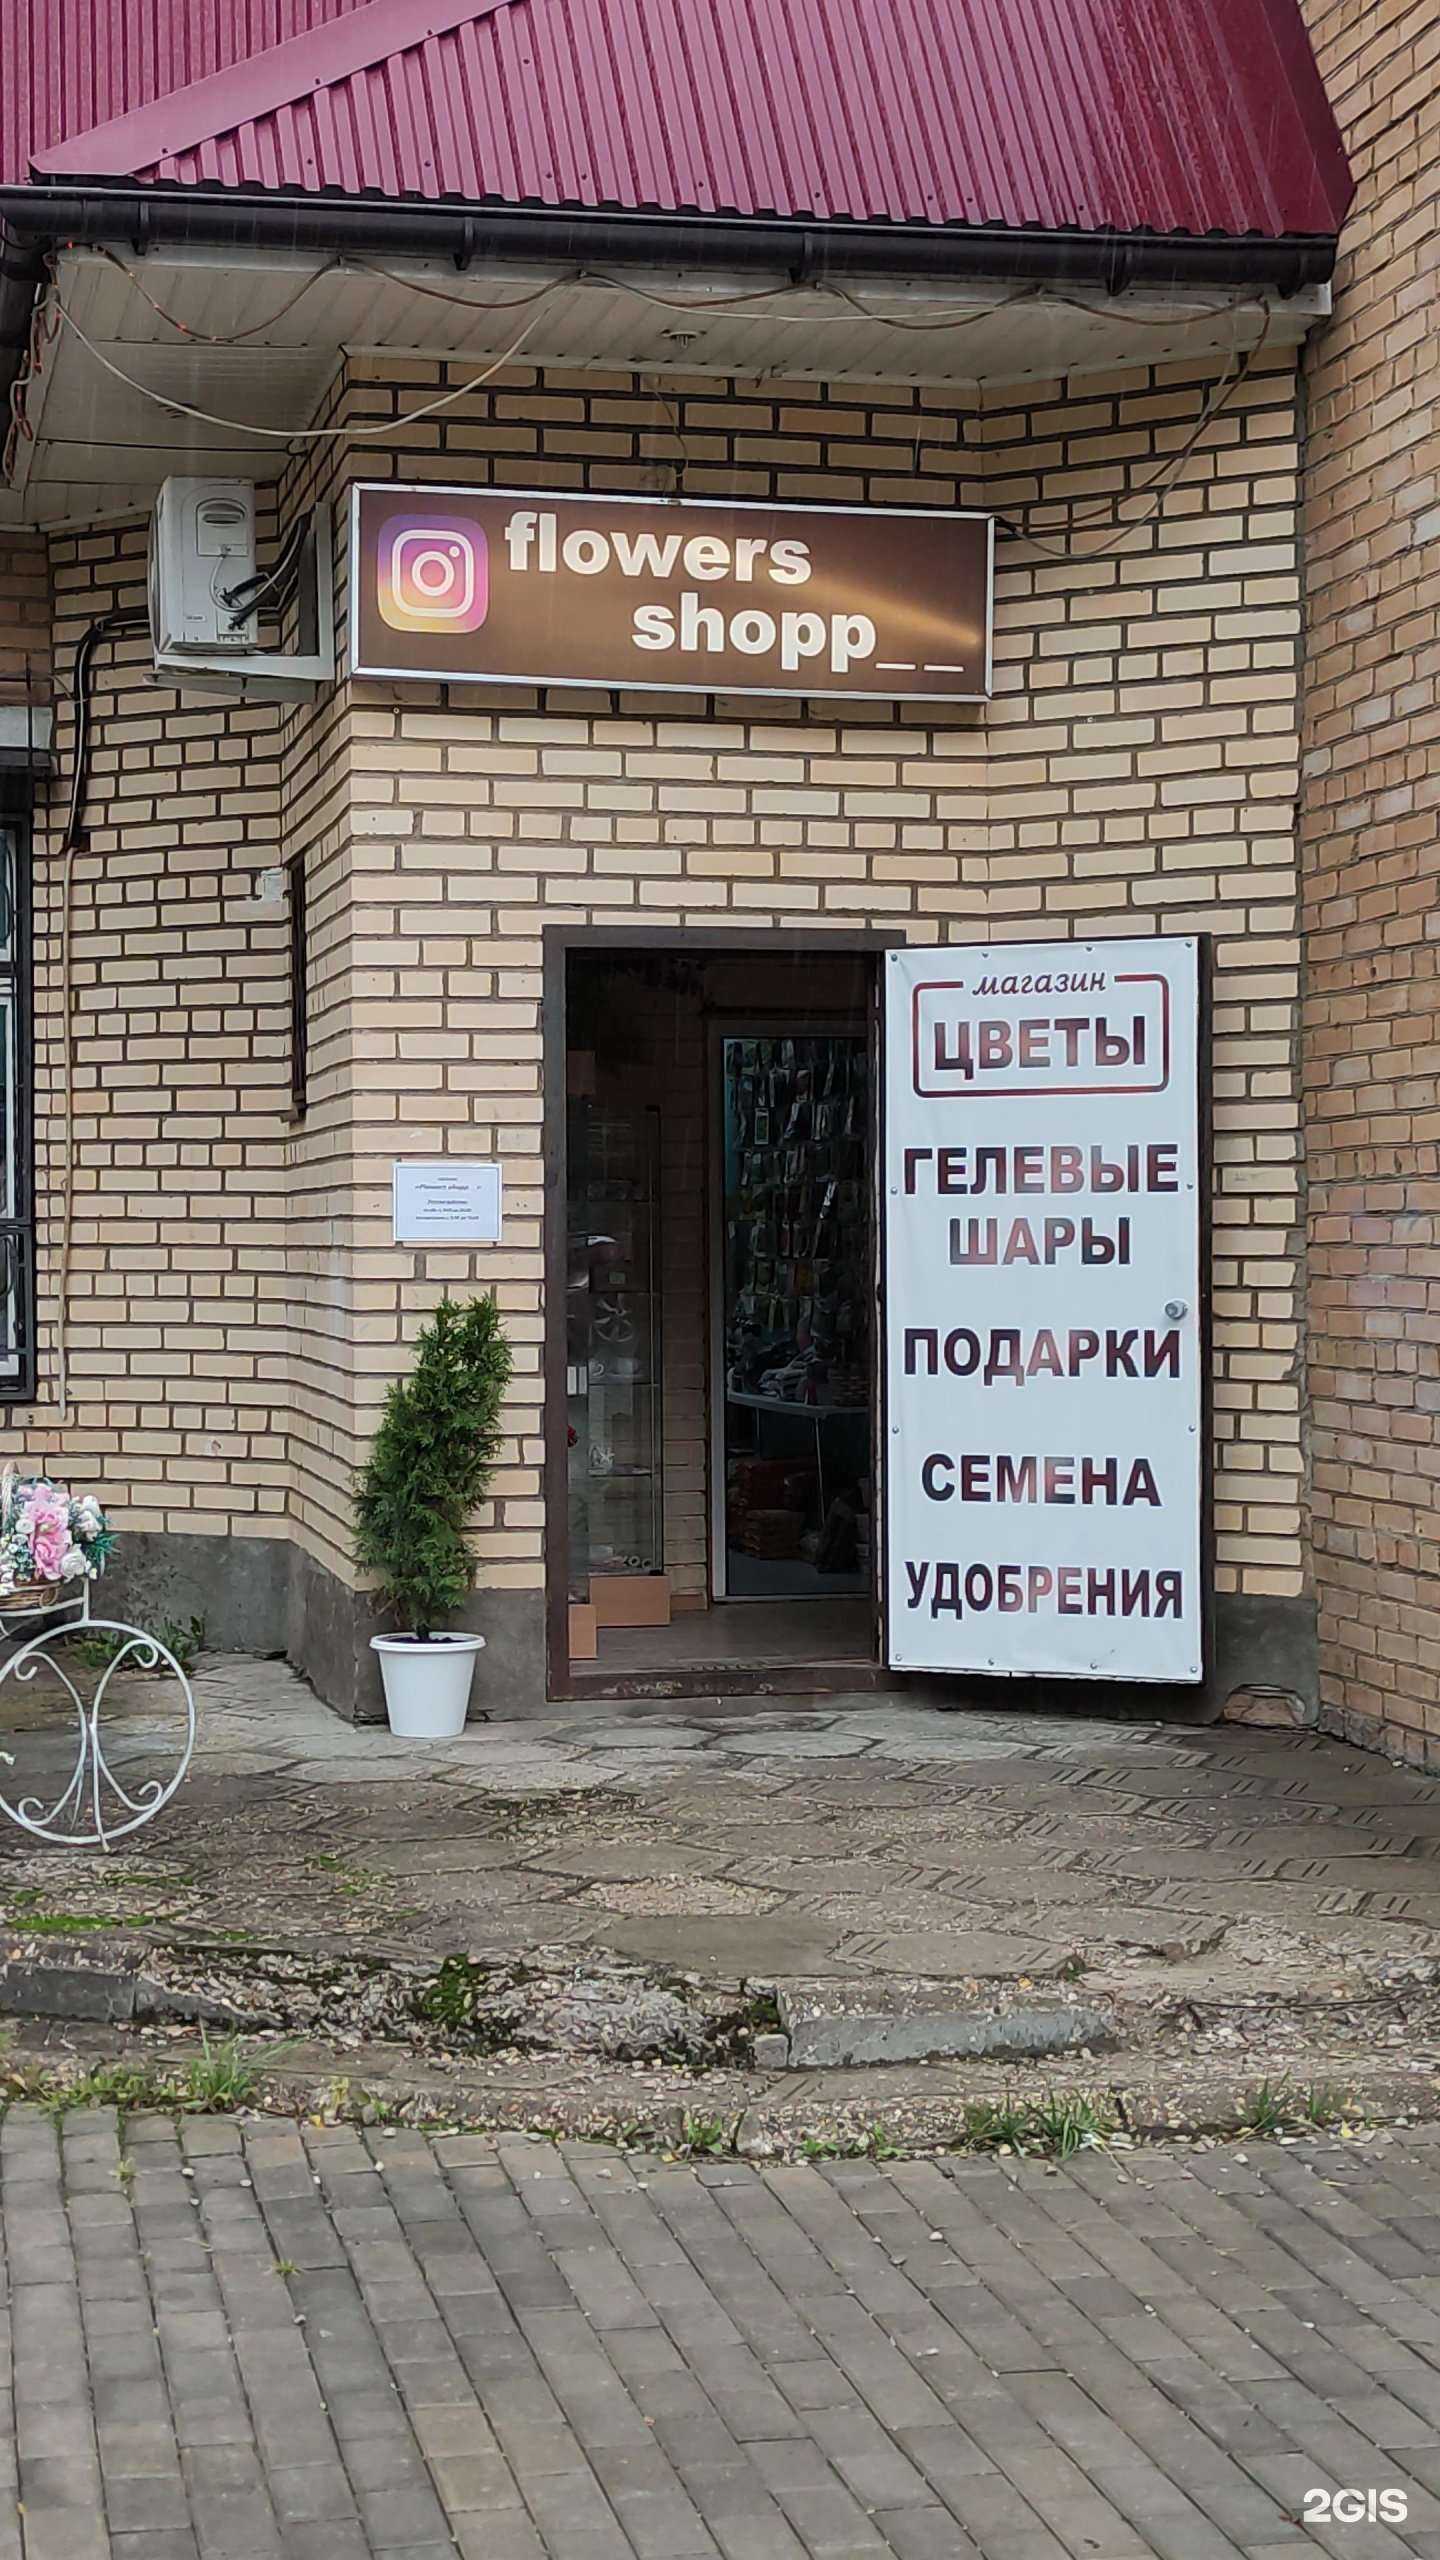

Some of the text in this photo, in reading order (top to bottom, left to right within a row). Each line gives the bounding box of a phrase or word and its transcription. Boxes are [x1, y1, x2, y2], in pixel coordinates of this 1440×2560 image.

[505, 510, 814, 585] flowers
[972, 971, 1108, 997] магазин
[933, 1015, 1146, 1081] ЦВЕТЫ
[903, 1143, 1180, 1195] ГЕЛЕВЫЕ
[948, 1216, 1132, 1266] ШАРЫ
[903, 1327, 1181, 1387] ПОДАРКИ
[921, 1453, 1163, 1507] СЕМЕНА
[904, 1560, 1184, 1620] УДОБРЕНИЯ
